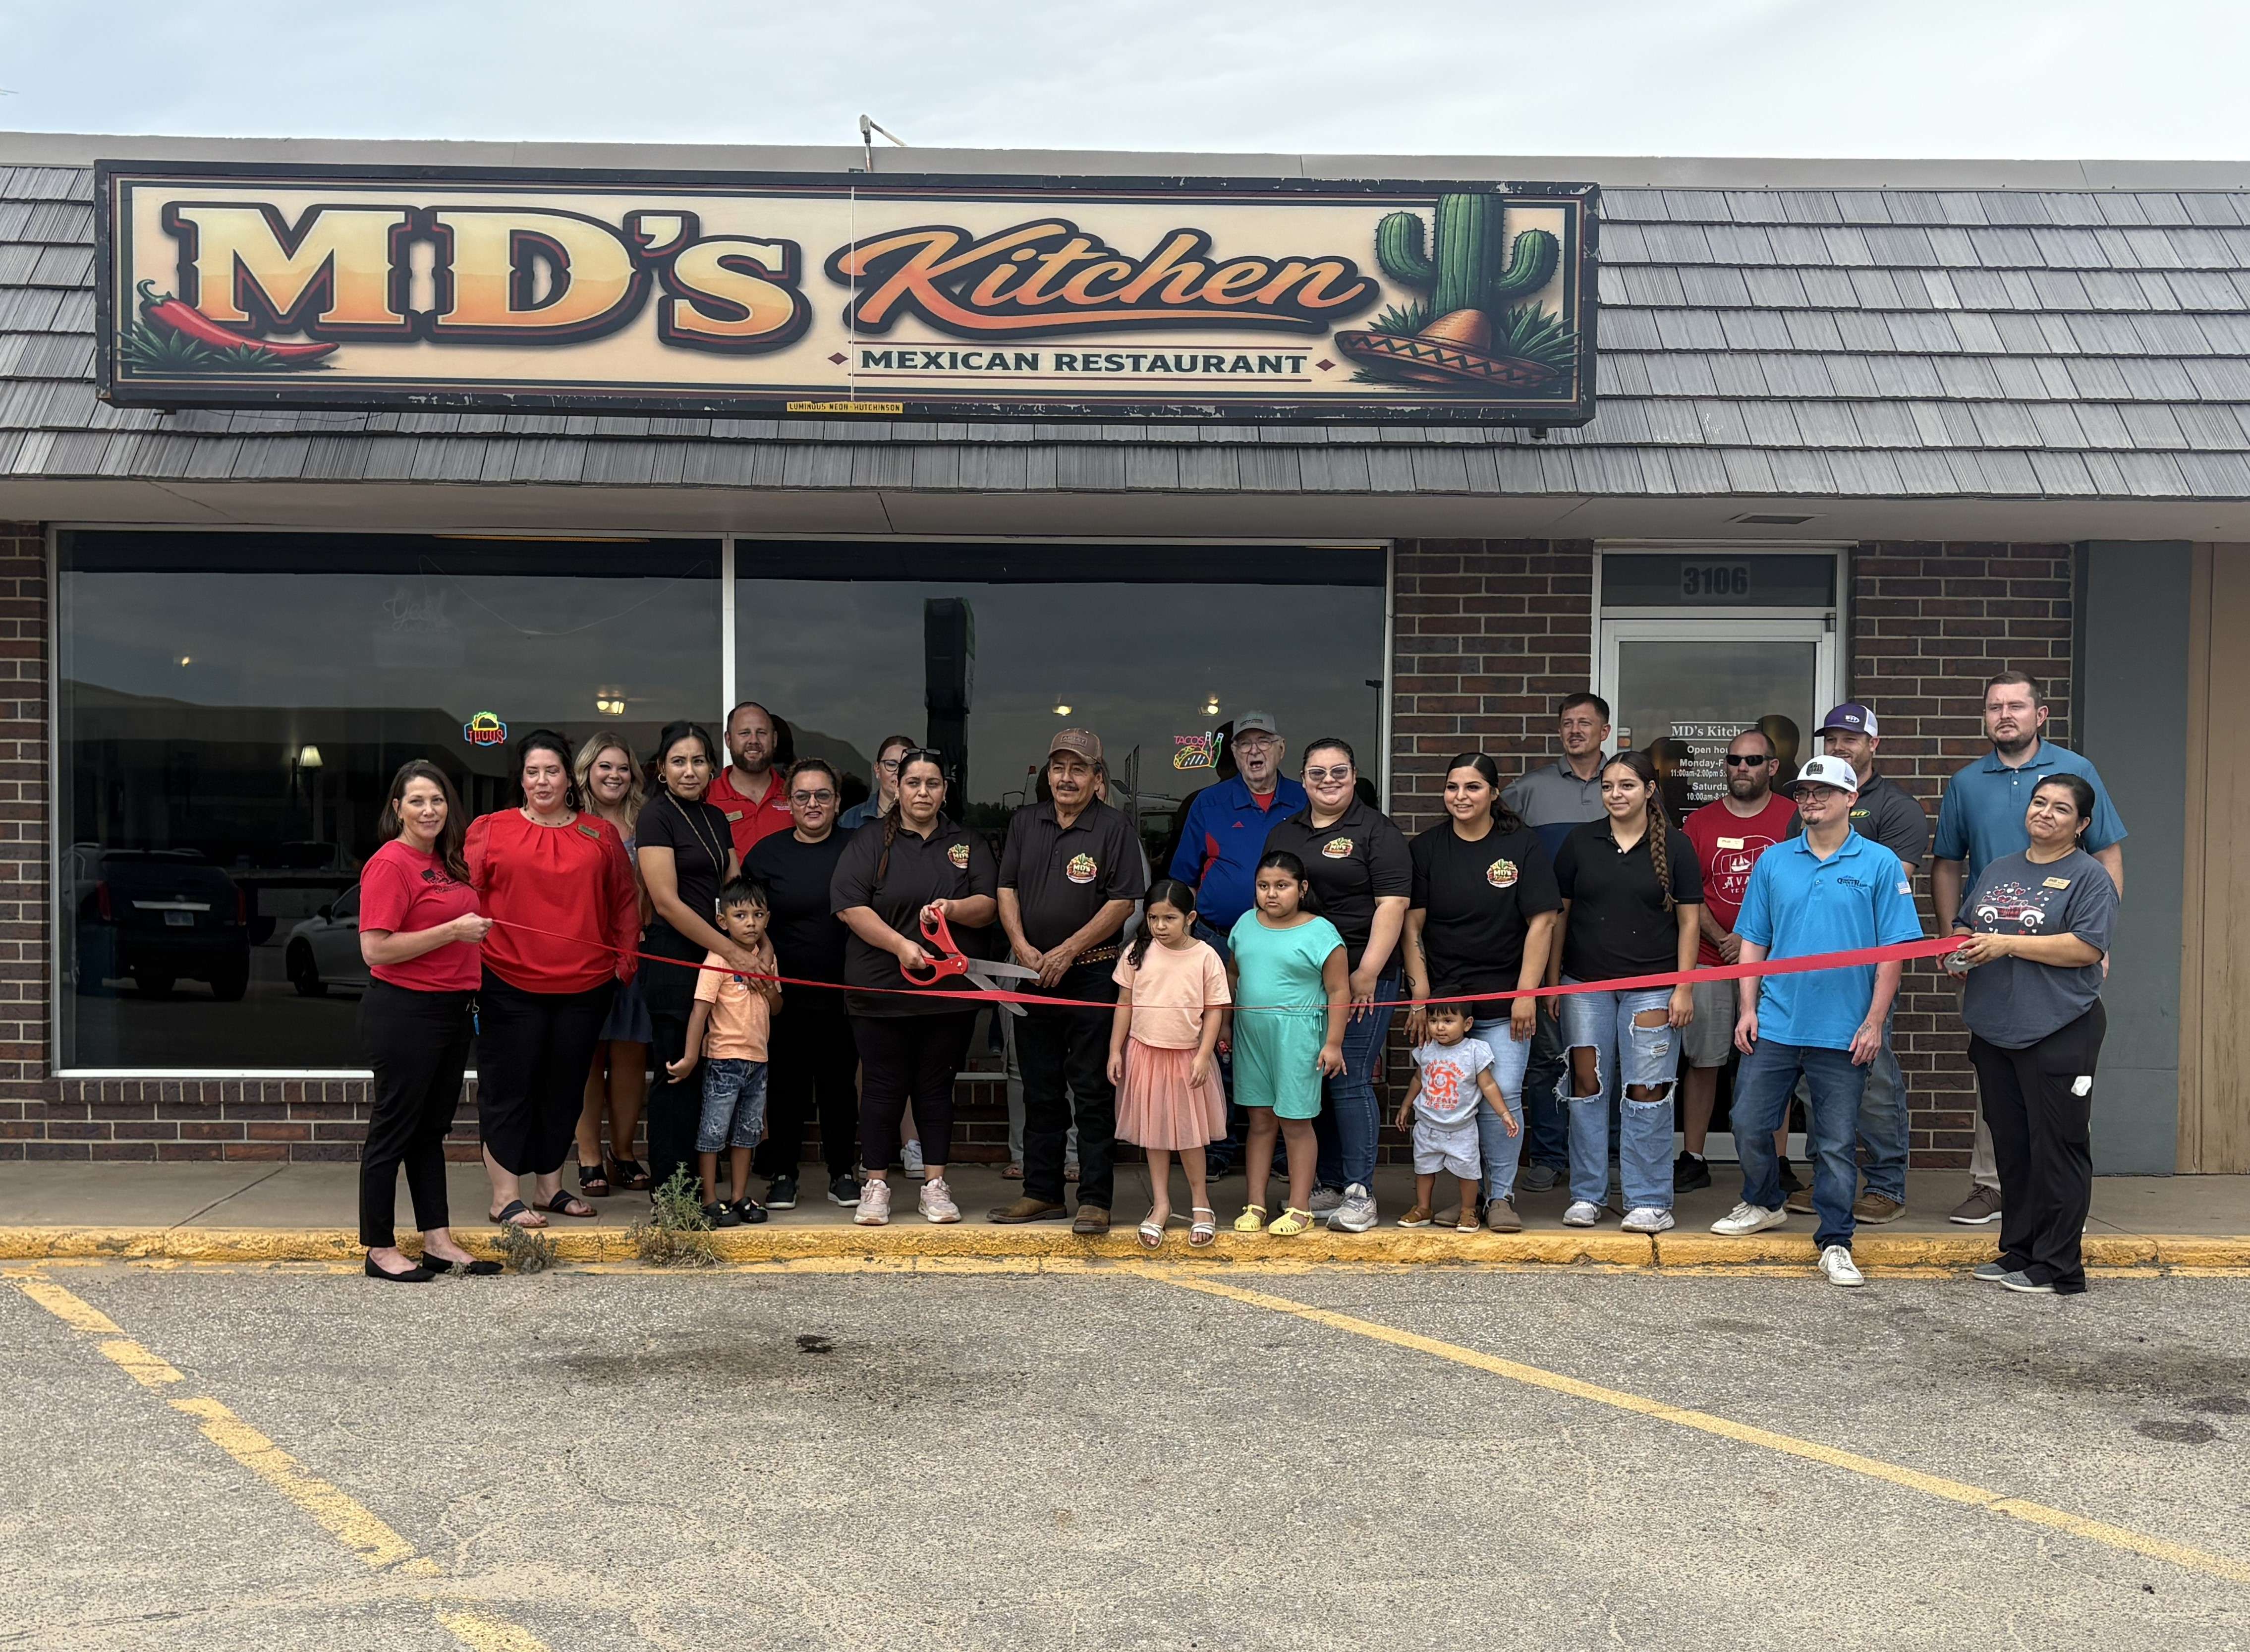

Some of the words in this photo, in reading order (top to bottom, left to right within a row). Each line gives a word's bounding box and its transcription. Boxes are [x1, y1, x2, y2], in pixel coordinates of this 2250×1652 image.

[167, 202, 808, 349] MD's
[831, 219, 1374, 333] Kitchen
[860, 350, 1040, 371] MEXICAN
[1054, 352, 1307, 374] RESTAURANT
[1684, 567, 1748, 595] 3106
[1671, 726, 1704, 737] MD's
[1174, 736, 1205, 745] TACOS
[1687, 745, 1711, 755] Open
[1671, 769, 1718, 779] 11:00am-2:00pm
[1691, 782, 1730, 792] Saturda
